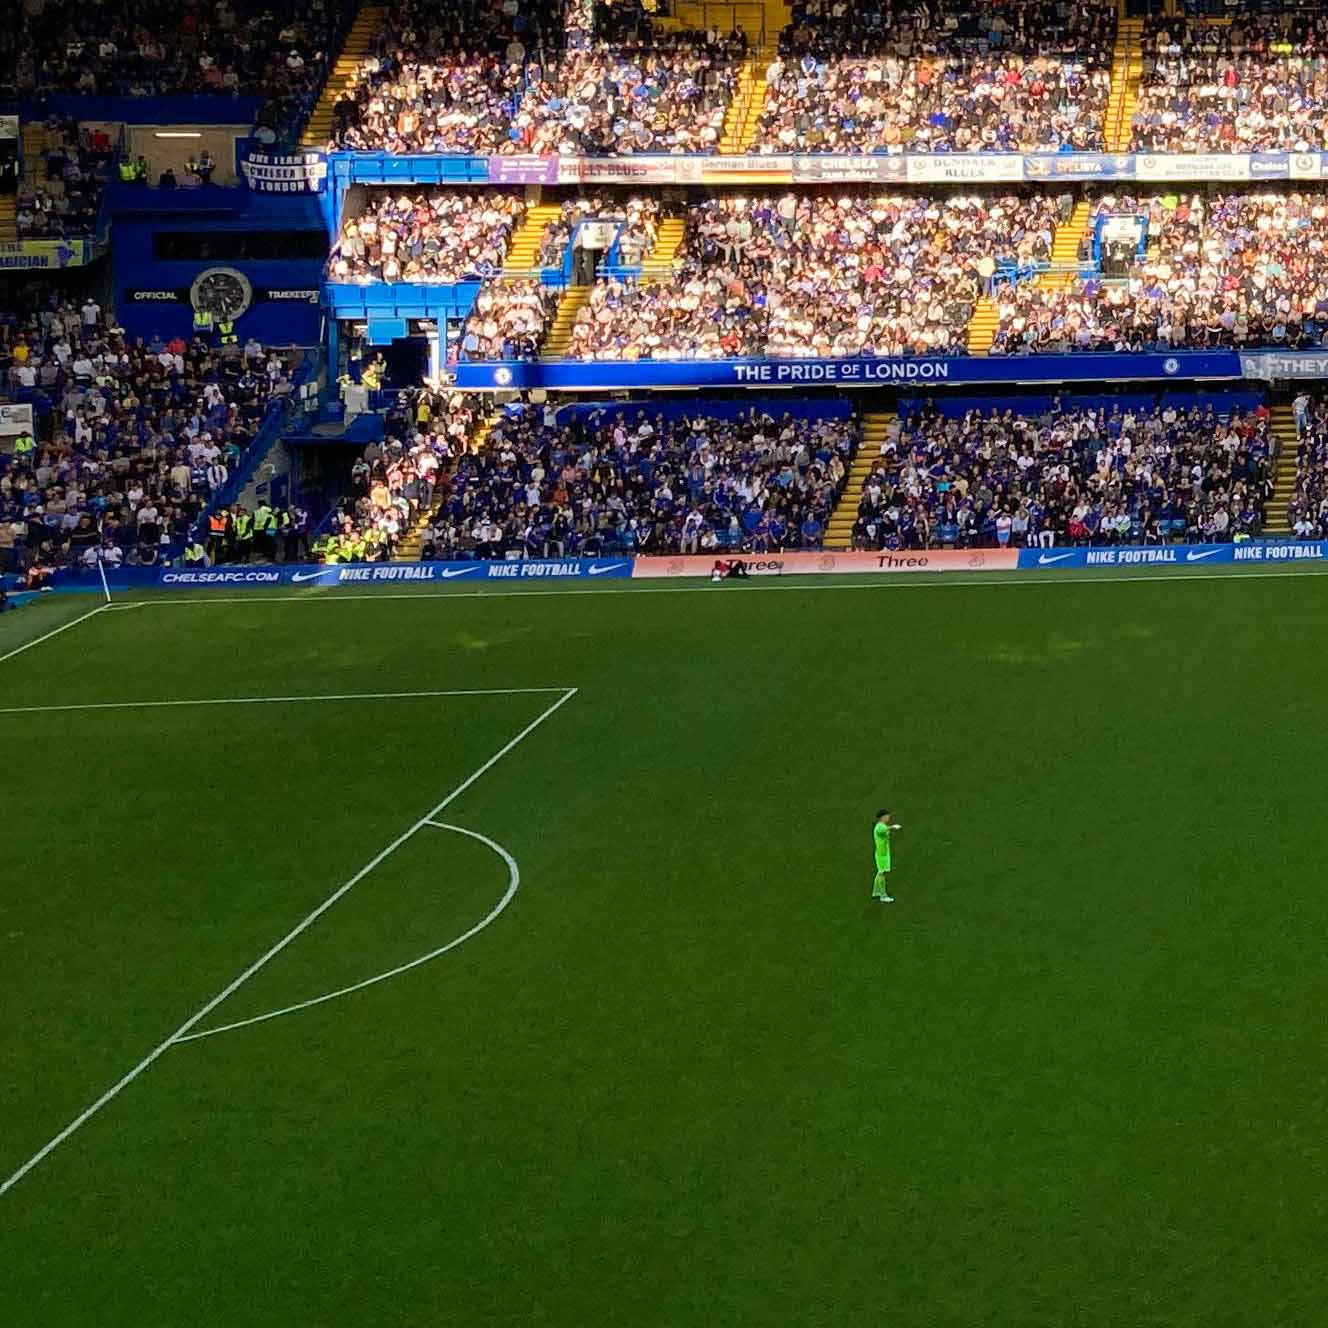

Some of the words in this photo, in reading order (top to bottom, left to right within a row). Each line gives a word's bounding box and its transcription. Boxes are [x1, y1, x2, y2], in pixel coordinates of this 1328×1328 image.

[607, 163, 648, 177] BLUES
[821, 158, 878, 170] CHELSEA
[249, 166, 296, 179] CHELSEA
[945, 168, 985, 178] BLUES
[134, 291, 178, 301] OFFICIAL
[733, 364, 771, 381] THE
[778, 364, 836, 380] PRIDE
[841, 363, 860, 377] OF
[865, 362, 948, 379] LONDON
[1281, 359, 1328, 373] THEY
[1087, 551, 1117, 563] NIKE
[1119, 550, 1177, 563] FOOTBALL
[1234, 548, 1264, 560] NIKE
[1265, 545, 1323, 559] FOOTBALL
[877, 554, 929, 569] Three
[339, 568, 371, 581] NIKE
[373, 566, 434, 581] FOOTBALL
[488, 565, 519, 577] NIKE
[521, 563, 581, 577] FOOTBALL
[162, 571, 280, 584] CHELSEAFC.COM
